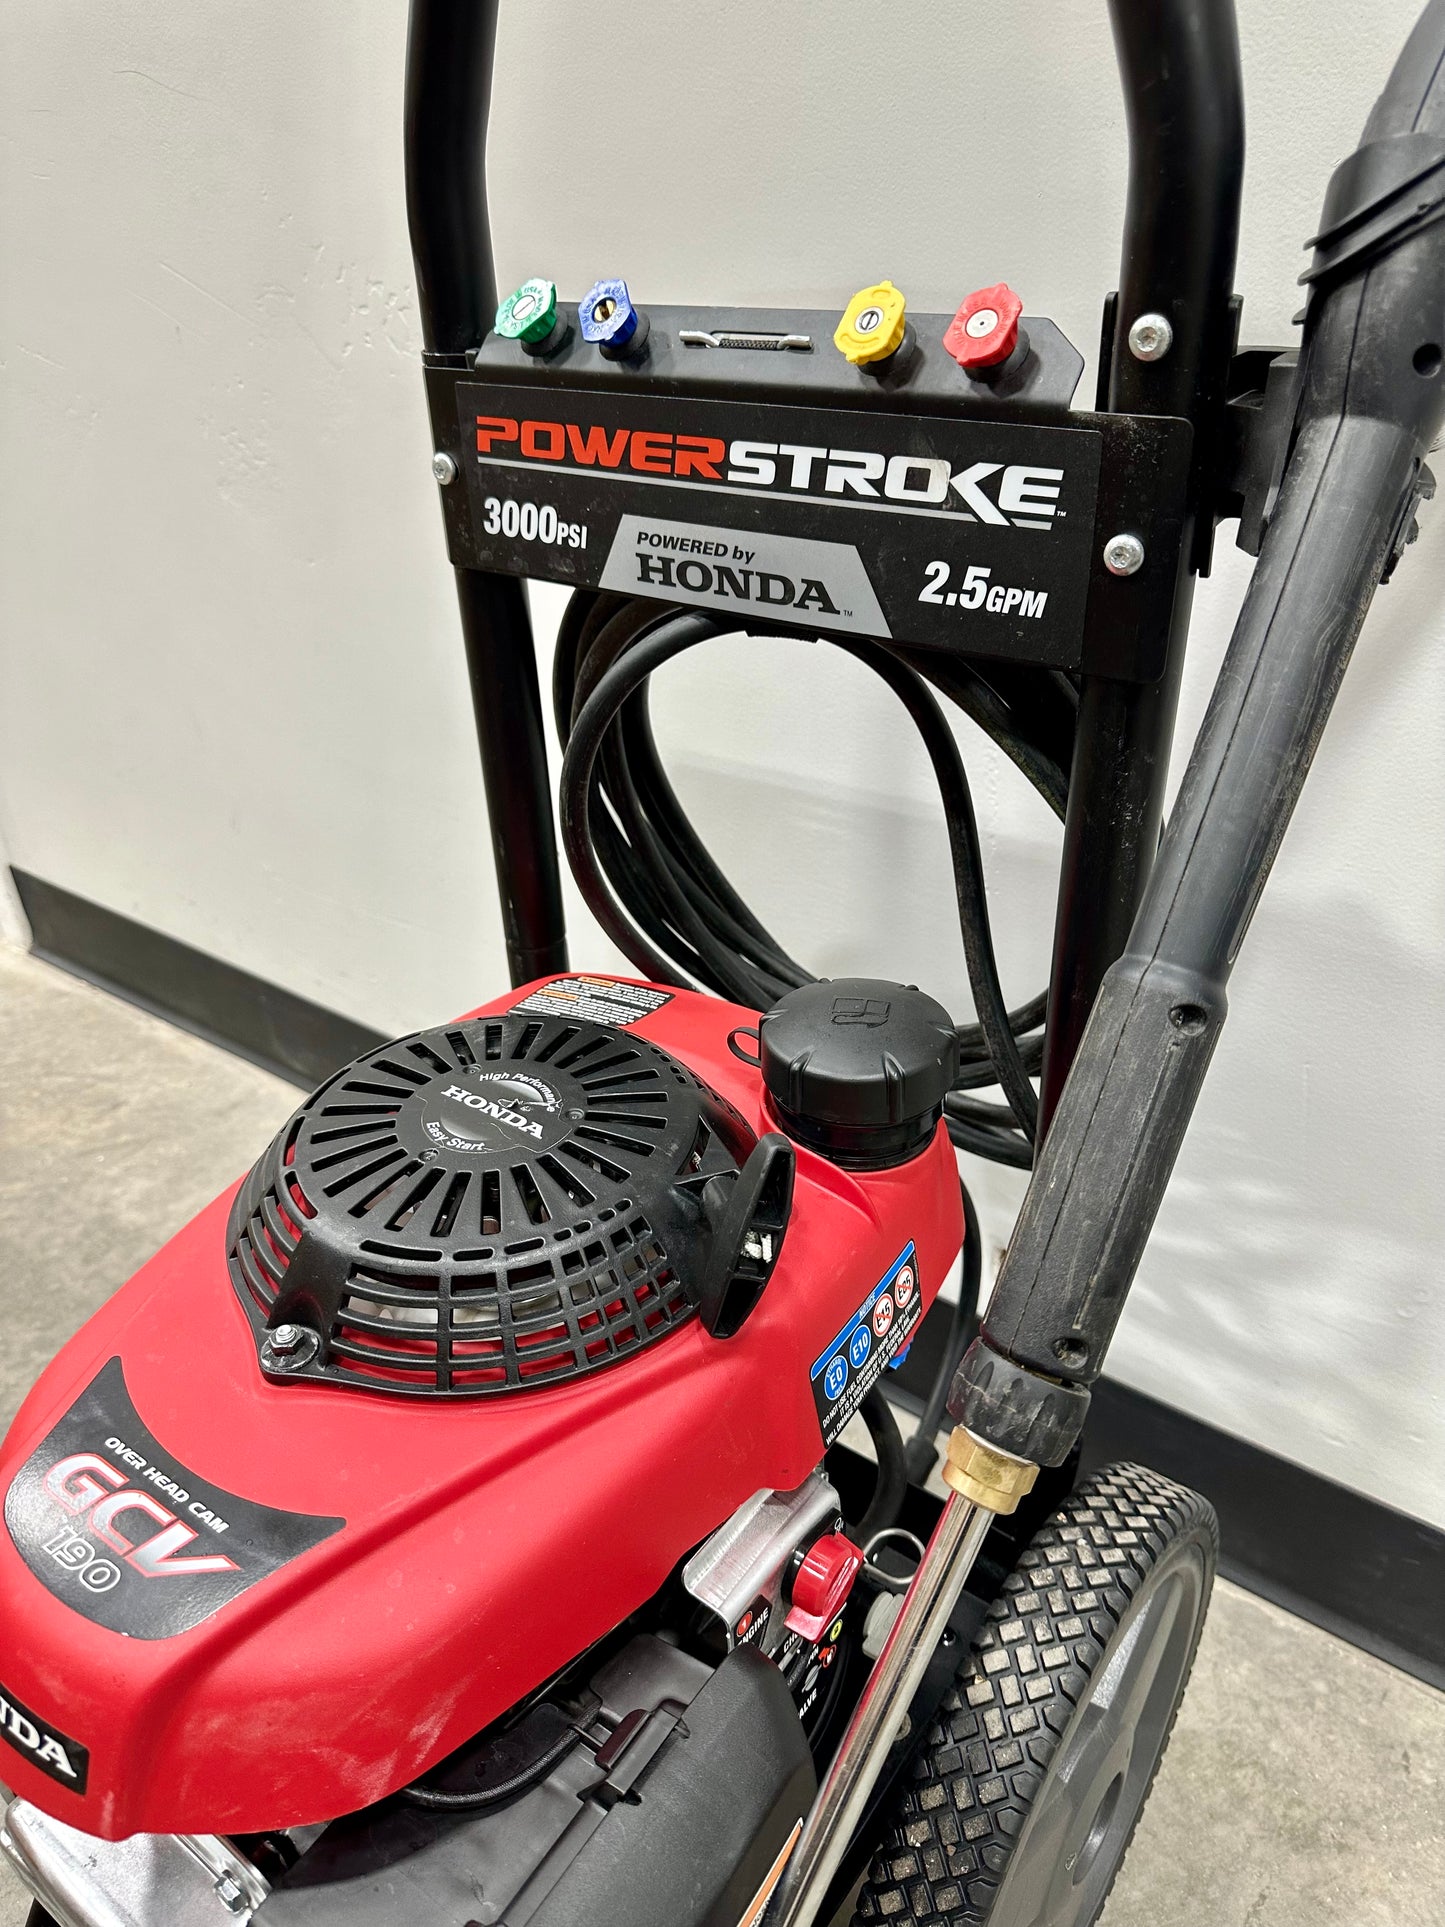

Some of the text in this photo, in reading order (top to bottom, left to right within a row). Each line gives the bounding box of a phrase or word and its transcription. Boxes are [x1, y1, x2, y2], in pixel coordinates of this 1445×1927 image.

[483, 497, 587, 550] 3000PSI
[636, 532, 756, 564] POWERED by
[635, 552, 840, 616] HONDA
[919, 561, 1047, 620] 2.5GPM
[480, 1072, 510, 1082] High
[427, 1121, 486, 1151] Easy Start
[441, 1085, 544, 1140] HONDA
[852, 1332, 868, 1360] E10
[829, 1366, 843, 1391] E0
[822, 1413, 830, 1429] DO
[829, 1403, 838, 1420] NOT
[838, 1391, 846, 1409] USE
[846, 1379, 856, 1398] FUEL
[840, 1405, 844, 1416] IT
[844, 1399, 849, 1410] IS
[826, 1427, 836, 1446] WILL
[104, 1437, 230, 1534] OVER HEAD CAM
[43, 1452, 241, 1578] GCV
[42, 1524, 121, 1593] 190
[799, 1688, 817, 1720] ALVE
[0, 1694, 78, 1778] NDA
